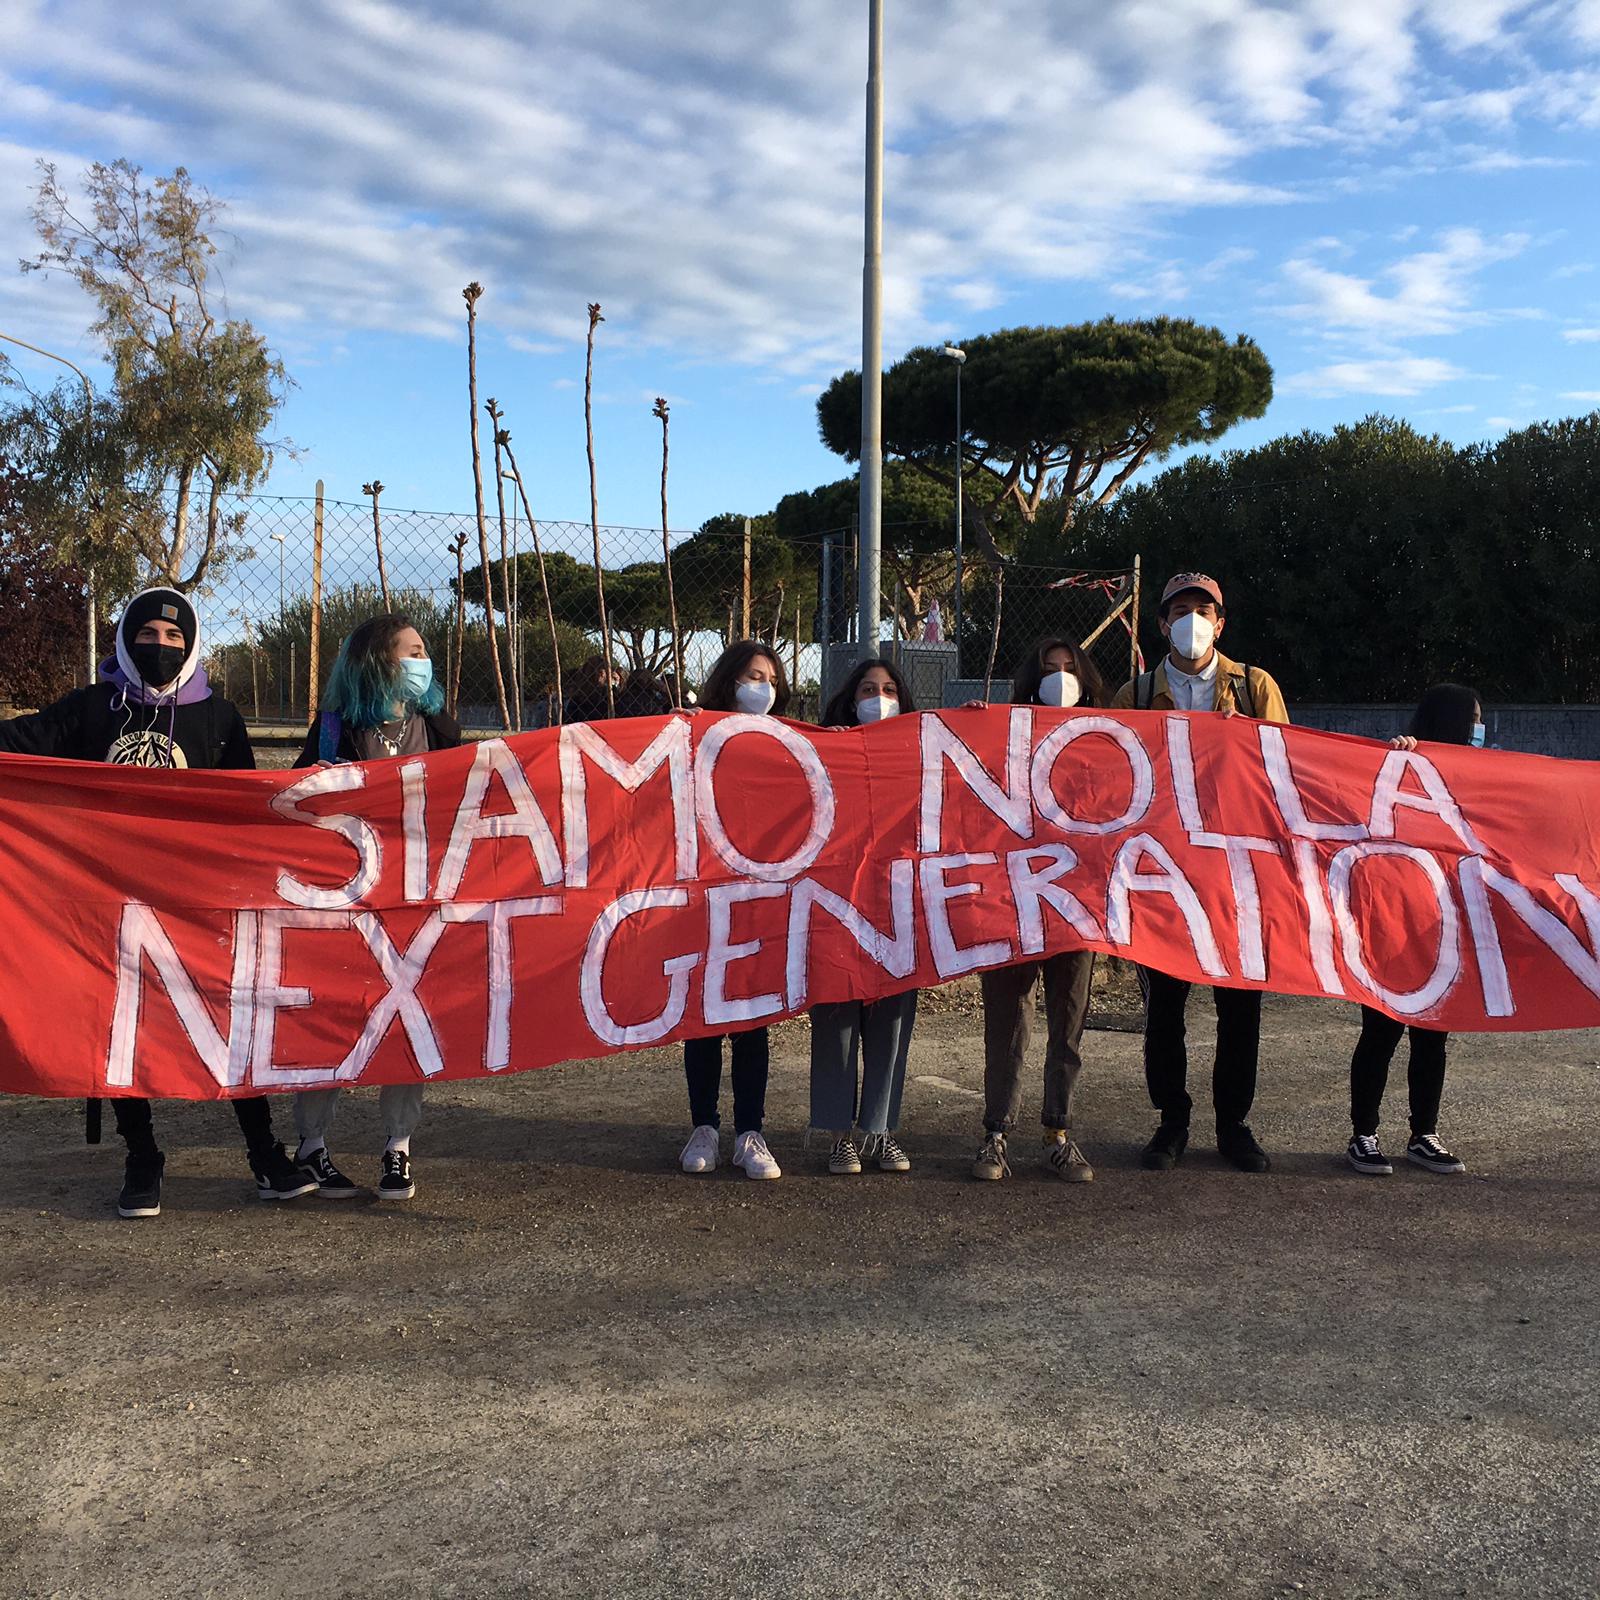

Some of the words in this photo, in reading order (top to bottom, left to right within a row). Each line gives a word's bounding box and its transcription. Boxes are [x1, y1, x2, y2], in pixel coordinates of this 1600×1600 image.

[271, 714, 837, 909] SIAMO
[919, 704, 1204, 852] NOI
[1257, 724, 1492, 862] LA
[105, 895, 565, 1088] NEXT
[579, 832, 1600, 1047] GENERATION
